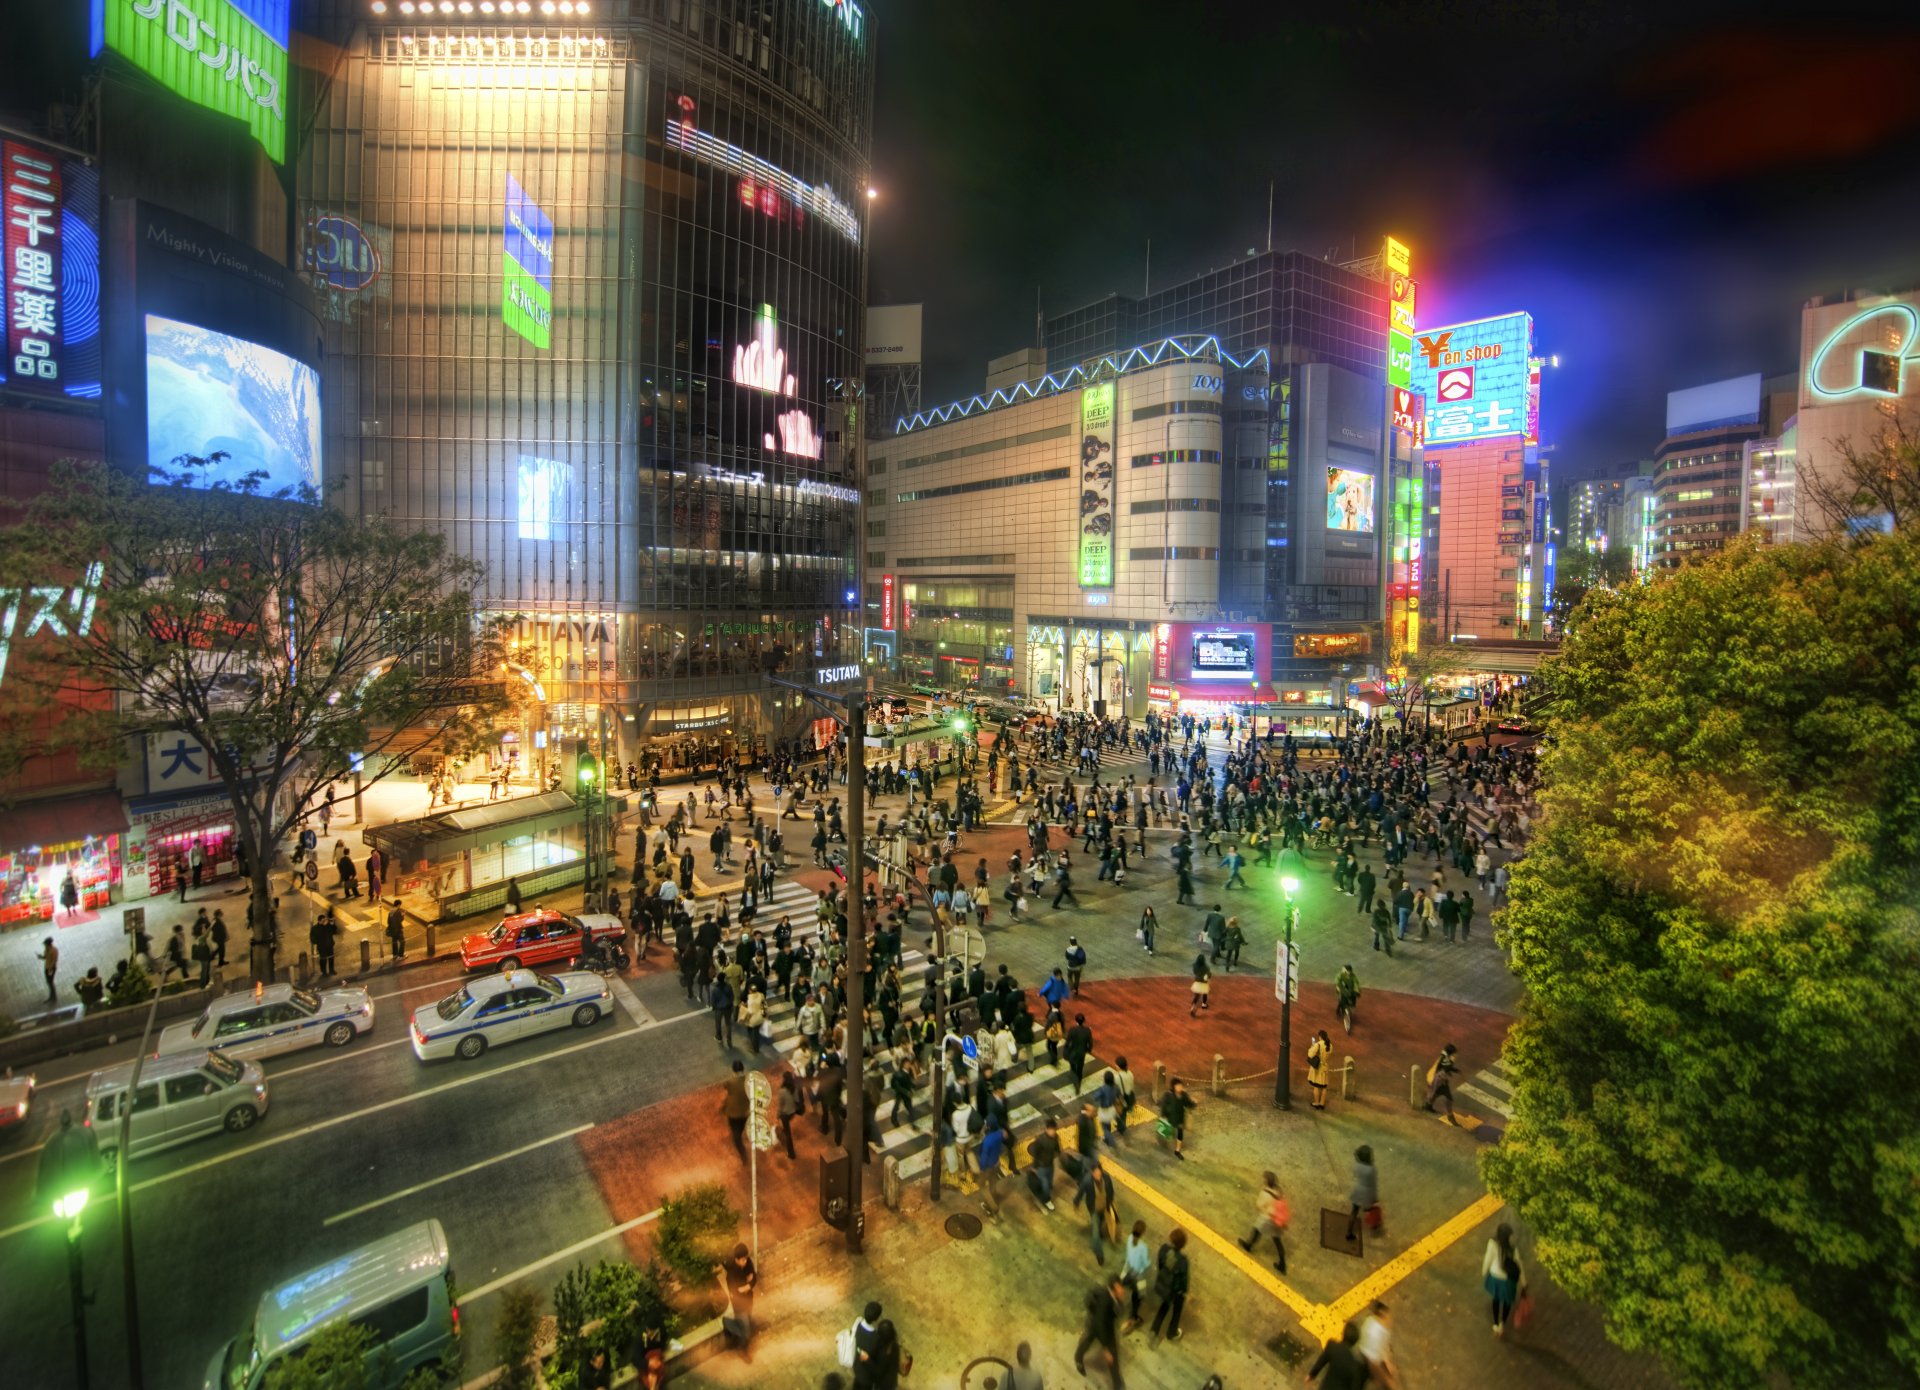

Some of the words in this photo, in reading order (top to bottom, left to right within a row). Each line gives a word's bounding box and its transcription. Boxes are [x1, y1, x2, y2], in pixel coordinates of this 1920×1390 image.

[147, 223, 205, 258] Mighty
[209, 248, 248, 273] Vision
[11, 154, 57, 379] 三千里薬品
[1465, 343, 1502, 362] shop
[1087, 406, 1109, 418] DEEP
[1425, 400, 1515, 438] 富士
[1085, 545, 1107, 554] DEEP
[818, 664, 860, 684] TSUTAYA
